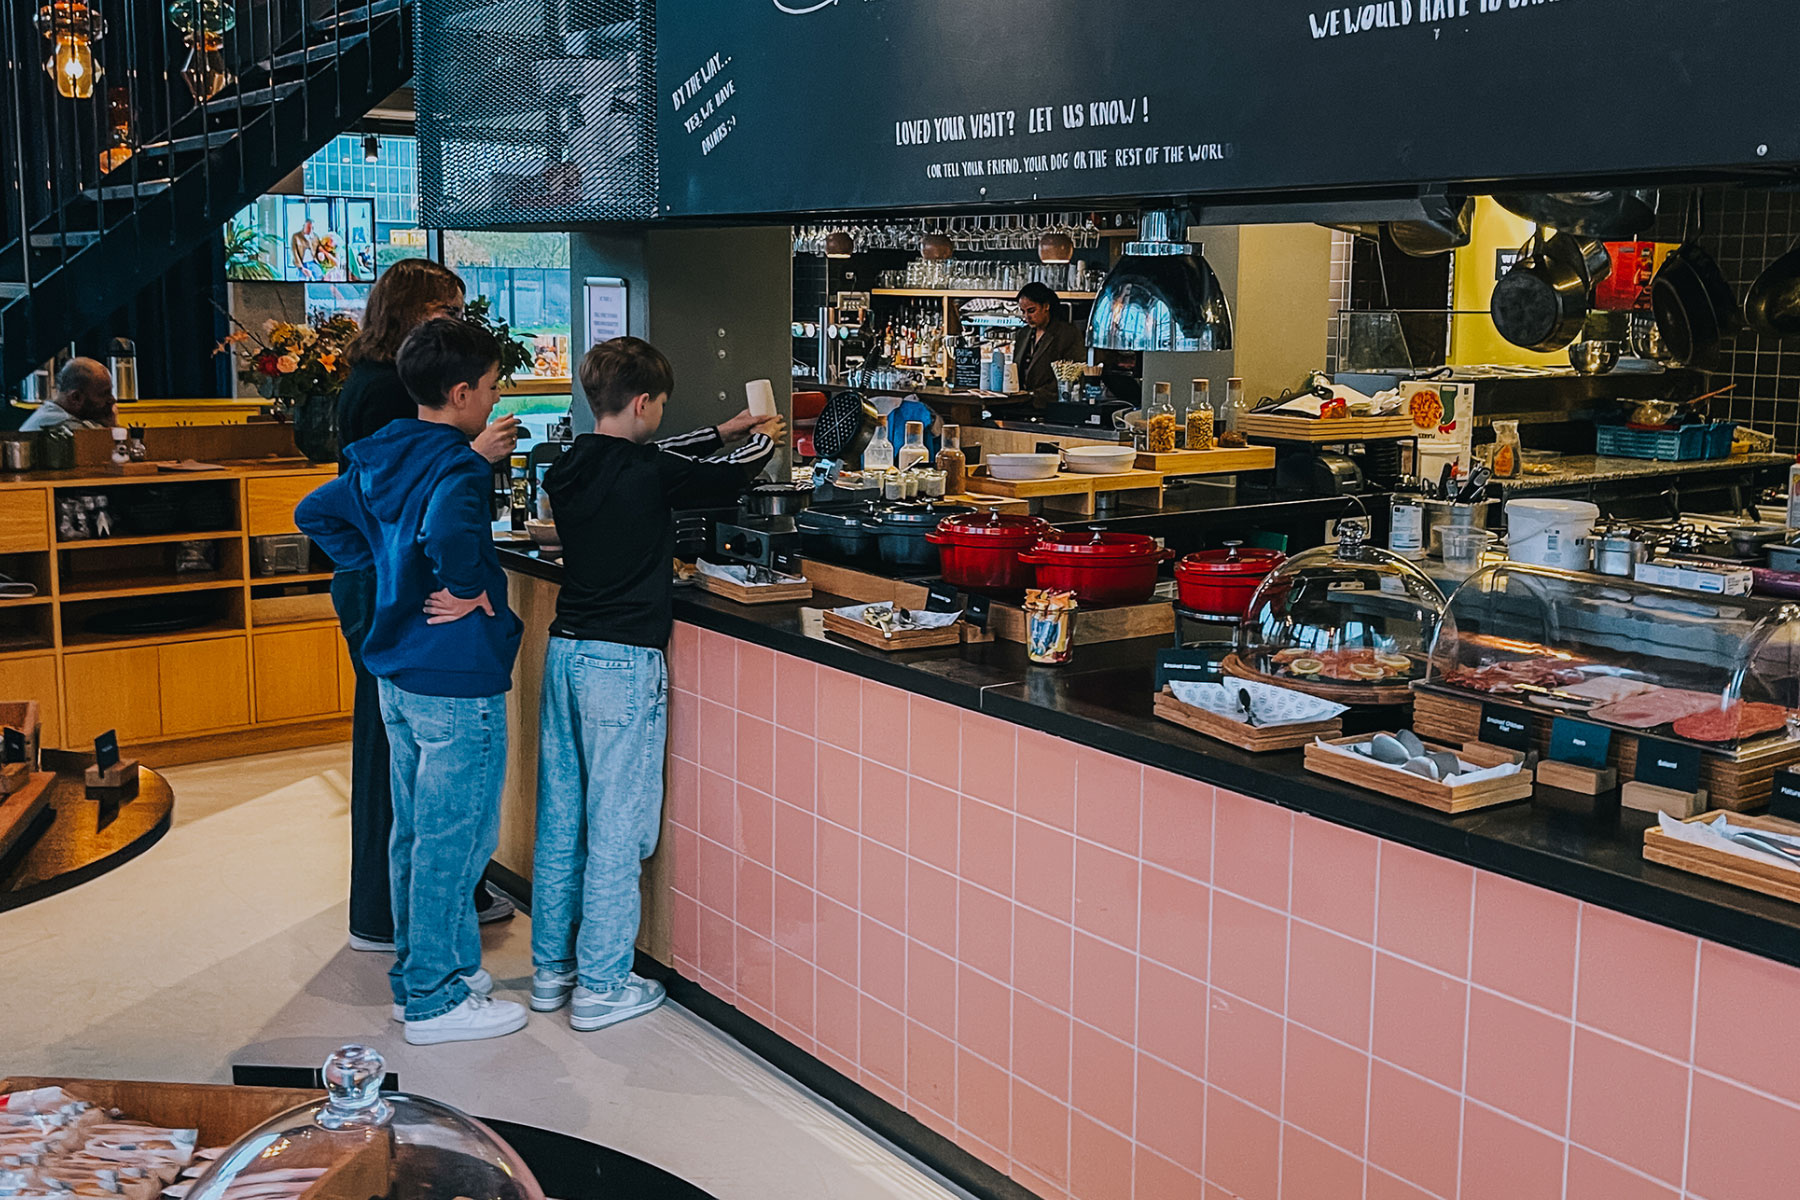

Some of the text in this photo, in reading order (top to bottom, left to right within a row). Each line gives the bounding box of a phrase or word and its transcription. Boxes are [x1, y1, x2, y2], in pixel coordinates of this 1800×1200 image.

[1308, 9, 1340, 39] WE
[1343, 0, 1413, 34] WOULD
[671, 86, 686, 112] BY
[684, 71, 702, 99] THE
[700, 99, 715, 120] WE
[714, 79, 736, 108] HAVE
[895, 119, 931, 146] LOVED
[934, 115, 967, 143] YOUR
[970, 110, 1016, 139] VISIT?
[1028, 106, 1053, 134] LET
[1062, 103, 1084, 129] US
[1089, 98, 1136, 127] KNOW
[943, 162, 960, 178] TELL
[961, 160, 985, 177] YOUR
[1023, 155, 1049, 173] YOUR
[1050, 152, 1069, 171] DOG
[1073, 150, 1087, 170] OR
[1088, 149, 1108, 169] THE
[1115, 147, 1143, 168] REST
[1145, 146, 1159, 165] OF
[1163, 145, 1185, 164] THE
